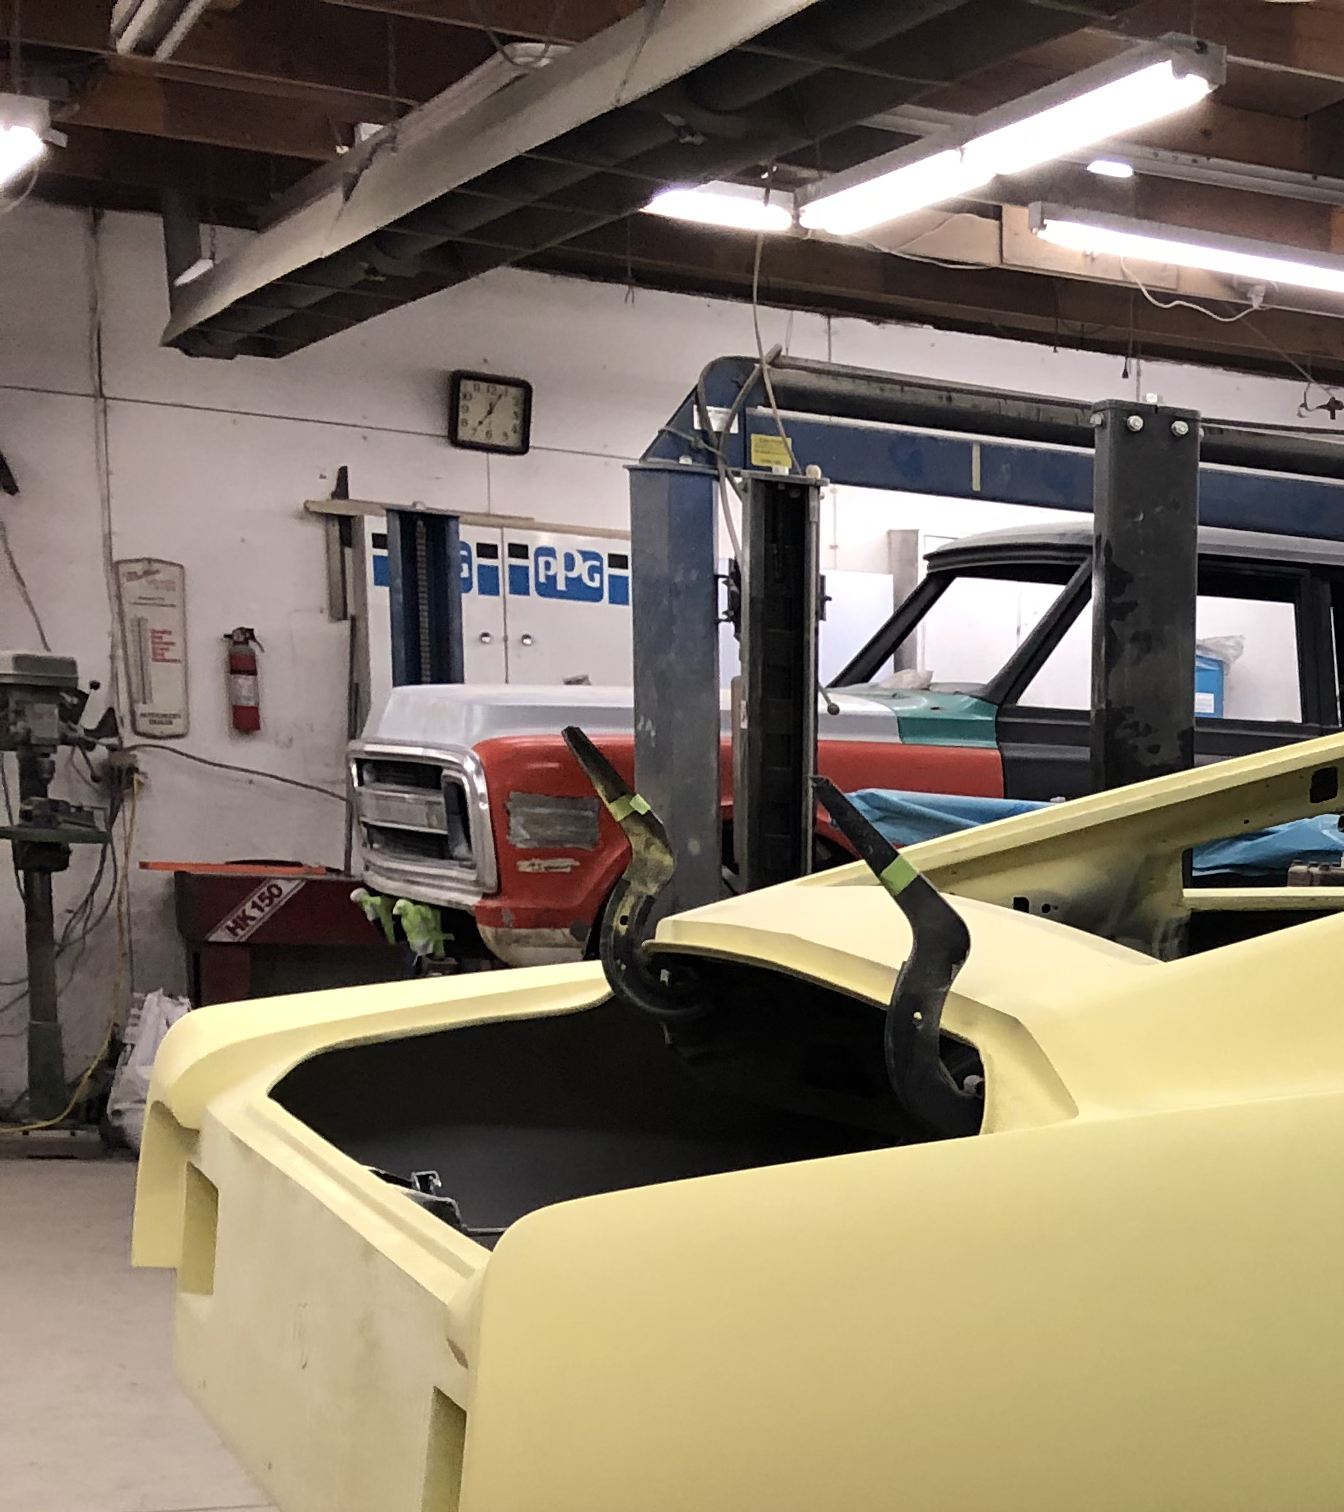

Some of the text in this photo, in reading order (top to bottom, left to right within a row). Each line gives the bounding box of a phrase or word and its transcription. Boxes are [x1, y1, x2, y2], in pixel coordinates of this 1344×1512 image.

[538, 546, 601, 592] PPG
[225, 883, 283, 937] HK 150
